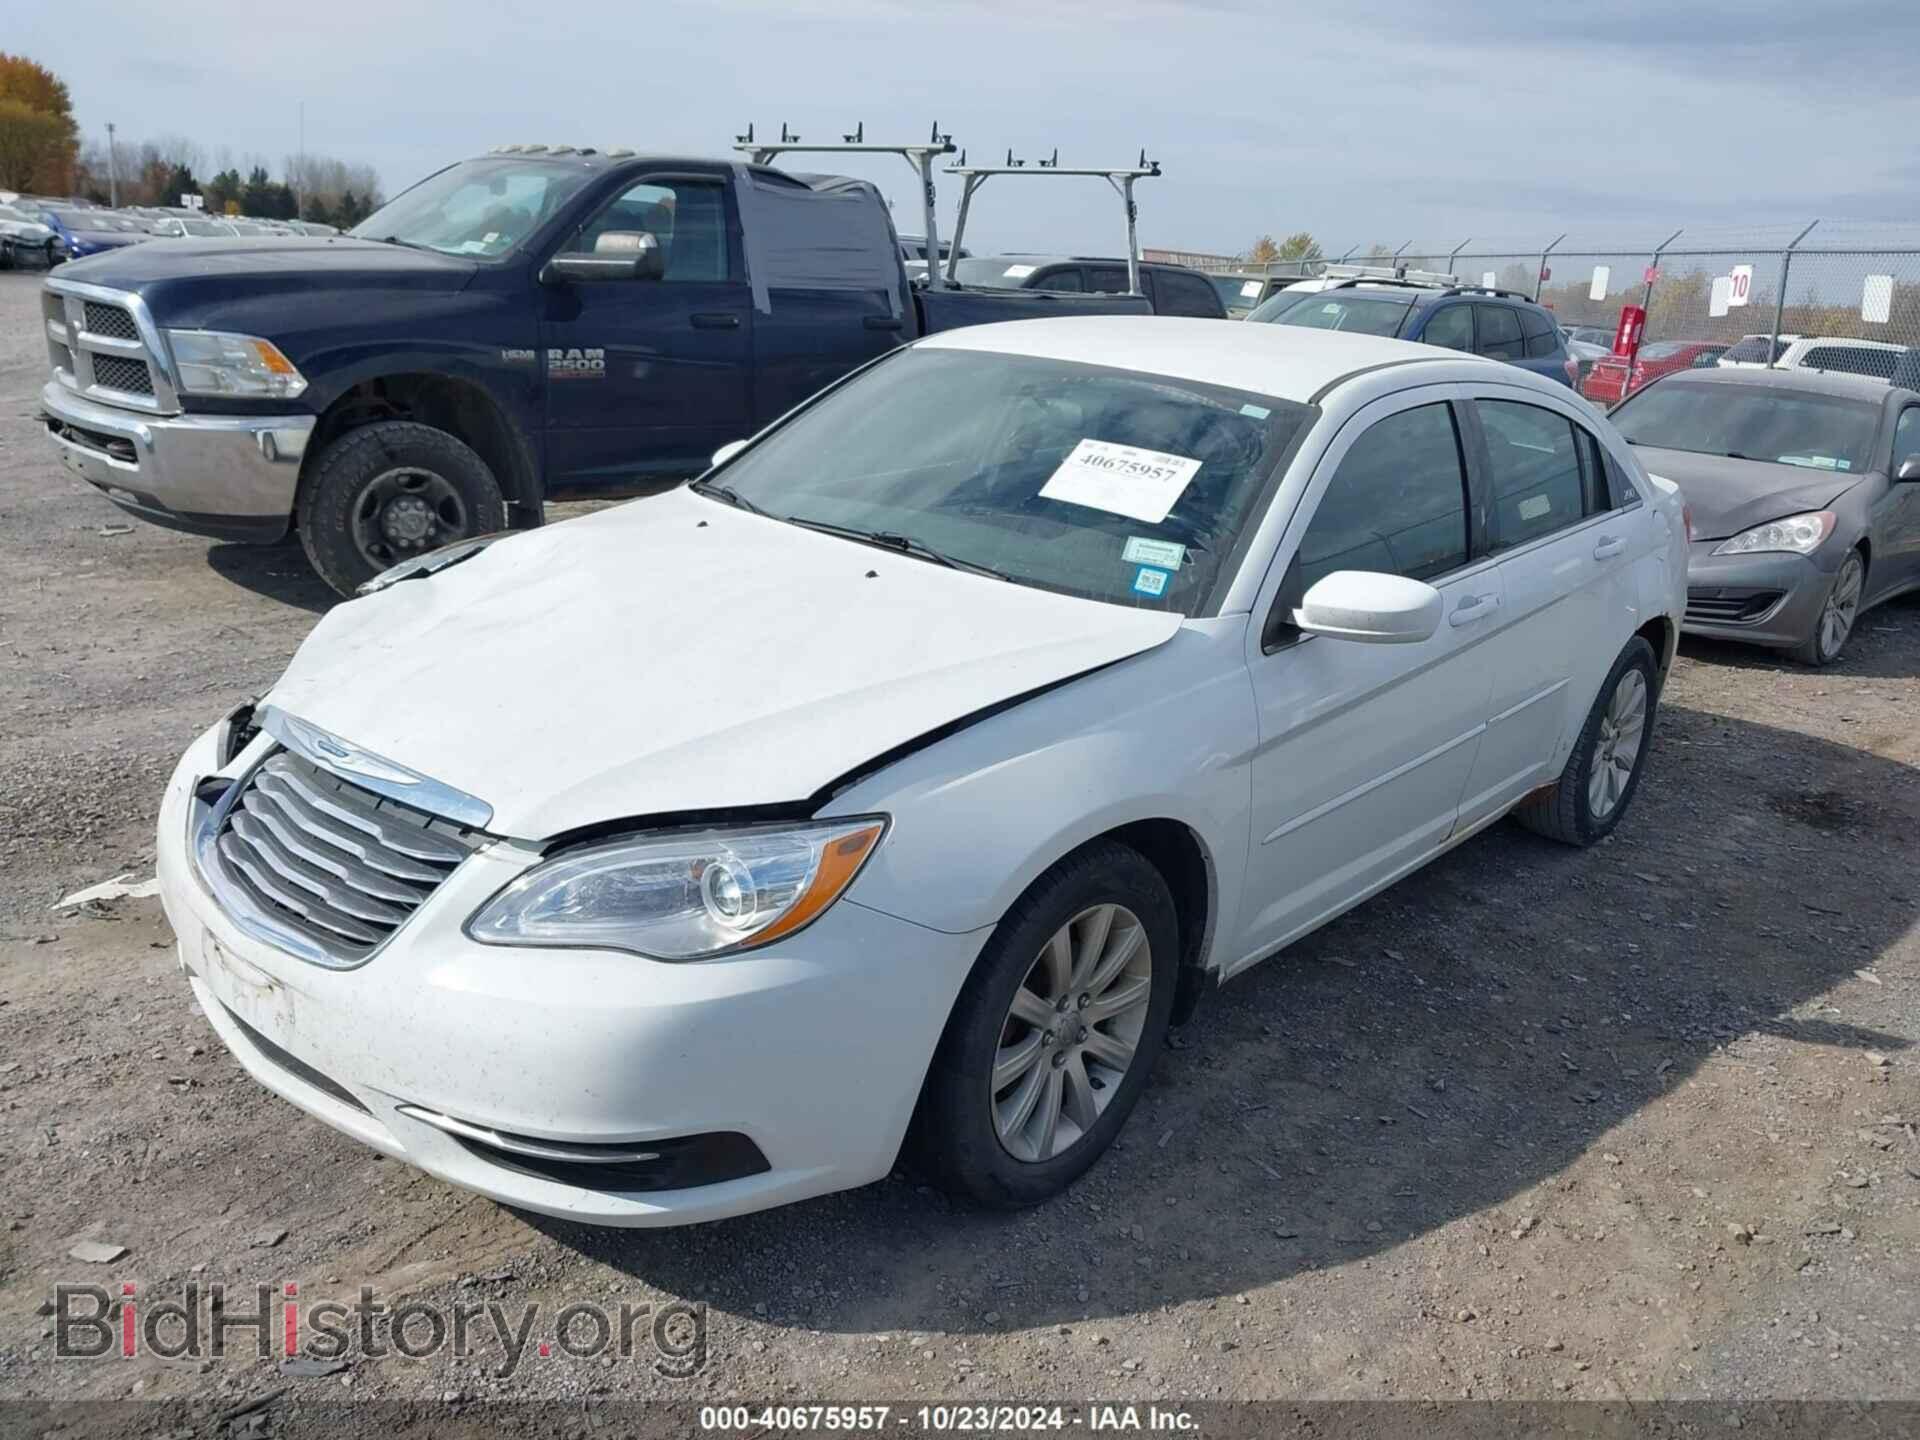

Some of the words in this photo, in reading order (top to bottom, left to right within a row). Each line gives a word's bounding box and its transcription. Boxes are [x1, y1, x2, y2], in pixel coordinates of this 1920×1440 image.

[1732, 274, 1748, 297] 10
[547, 348, 605, 359] RAM
[548, 359, 606, 369] 2500
[1080, 453, 1177, 483] 40675957
